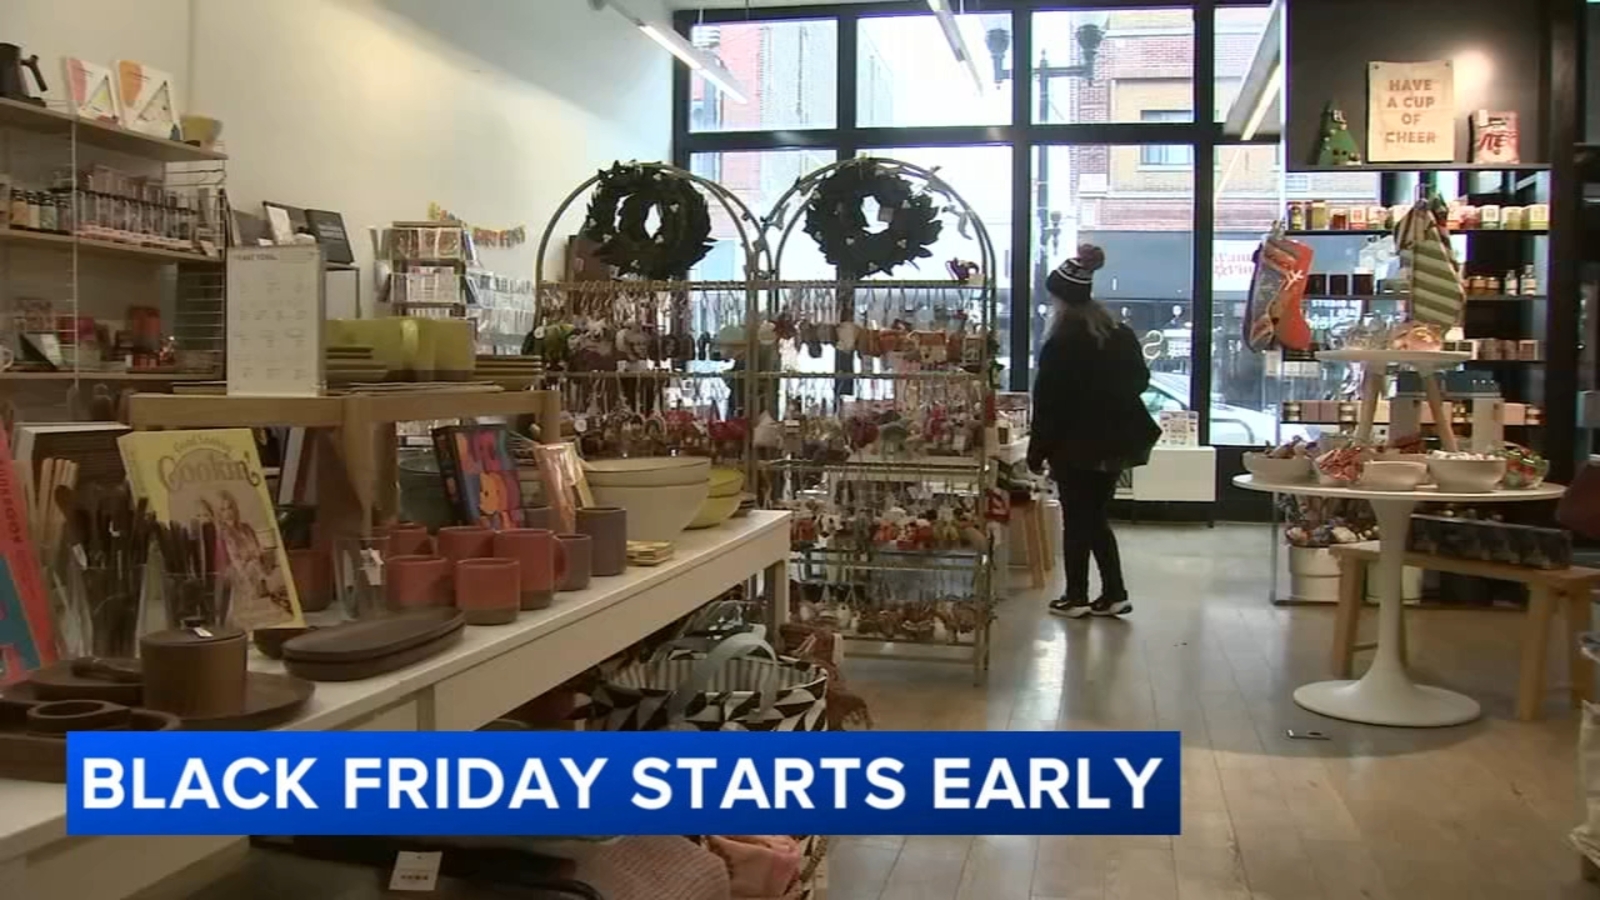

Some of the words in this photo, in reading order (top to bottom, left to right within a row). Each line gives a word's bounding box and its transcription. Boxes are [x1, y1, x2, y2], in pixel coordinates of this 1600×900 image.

[1389, 79, 1432, 91] HAVE
[1387, 97, 1397, 108] A
[1403, 97, 1434, 108] CUP
[1401, 113, 1420, 125] OF
[1385, 131, 1436, 143] CHEER
